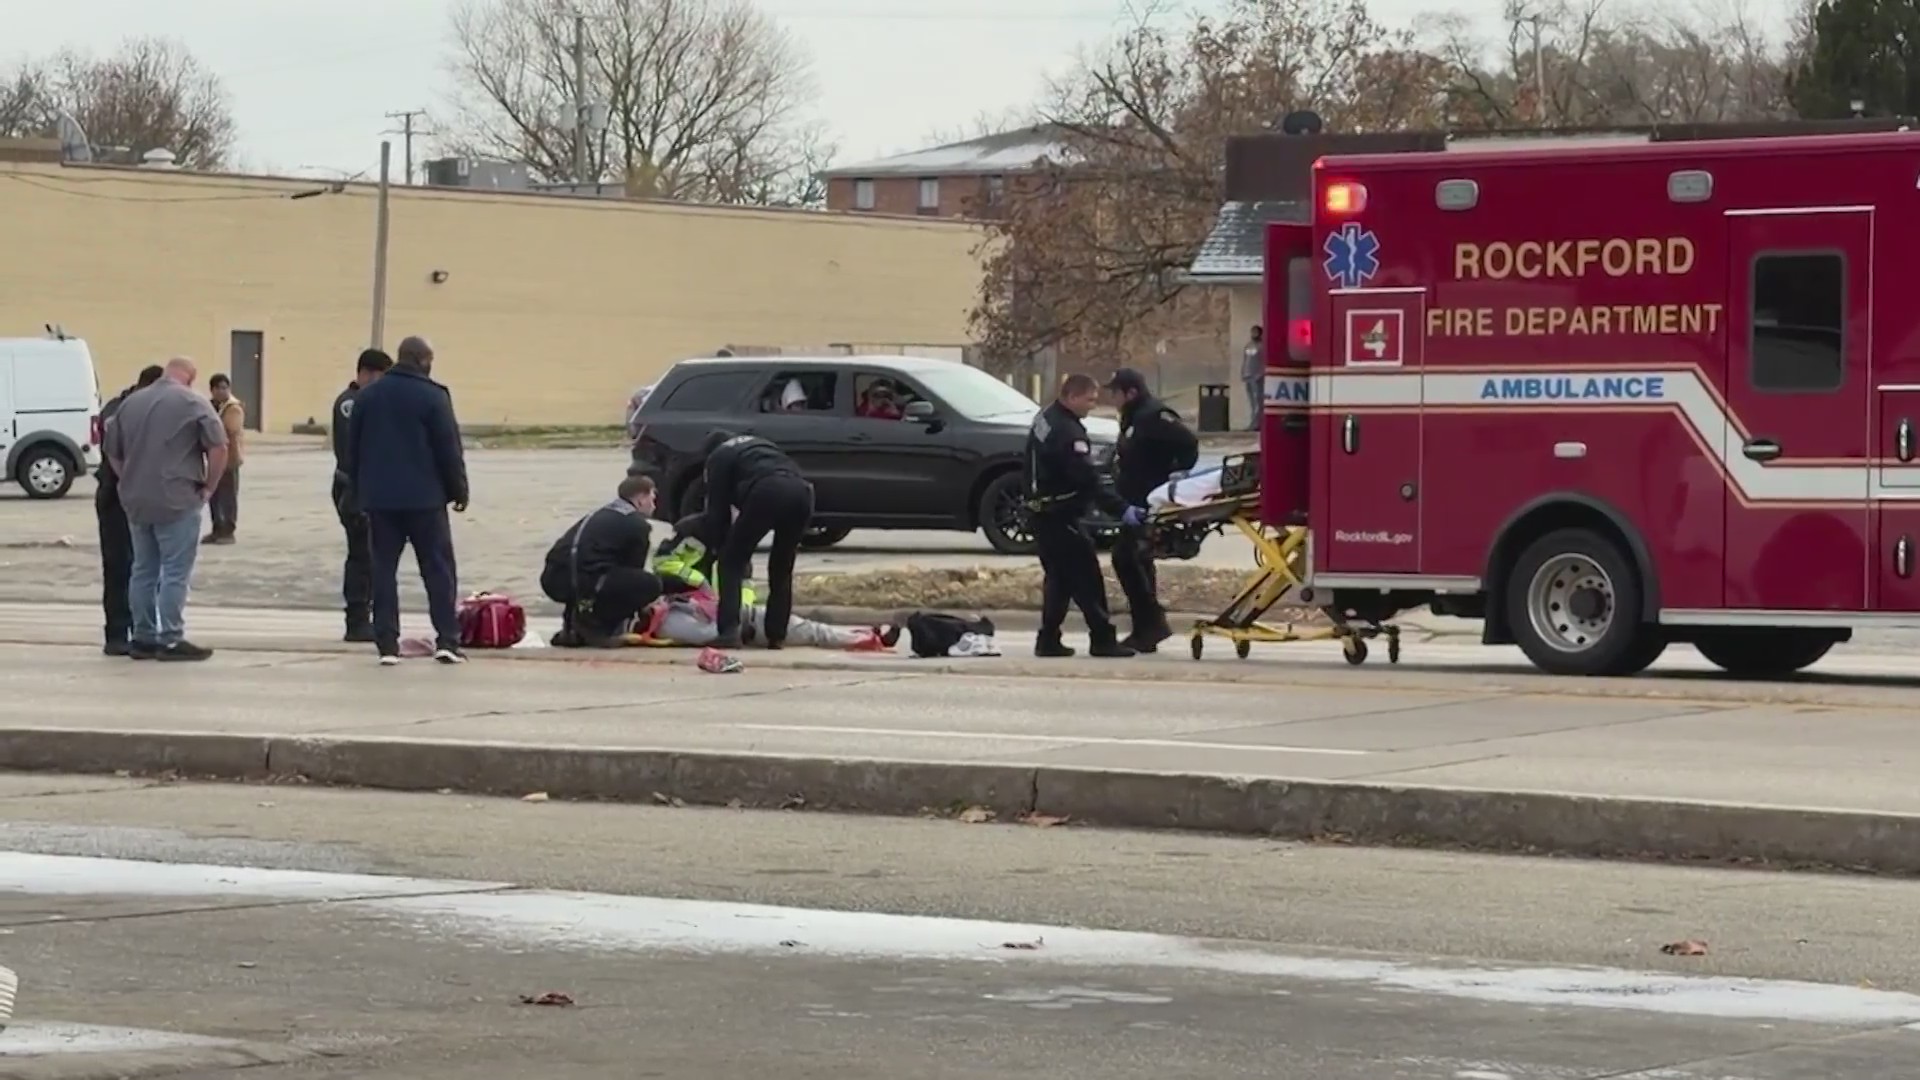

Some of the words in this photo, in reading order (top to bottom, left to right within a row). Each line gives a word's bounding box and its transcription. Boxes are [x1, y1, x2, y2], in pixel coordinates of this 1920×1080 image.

[1455, 237, 1695, 280] ROCKFORD
[1427, 307, 1494, 336] FIRE
[1505, 304, 1722, 336] DEPARTMENT
[1362, 319, 1387, 358] 4
[1480, 377, 1665, 399] AMBULANCE
